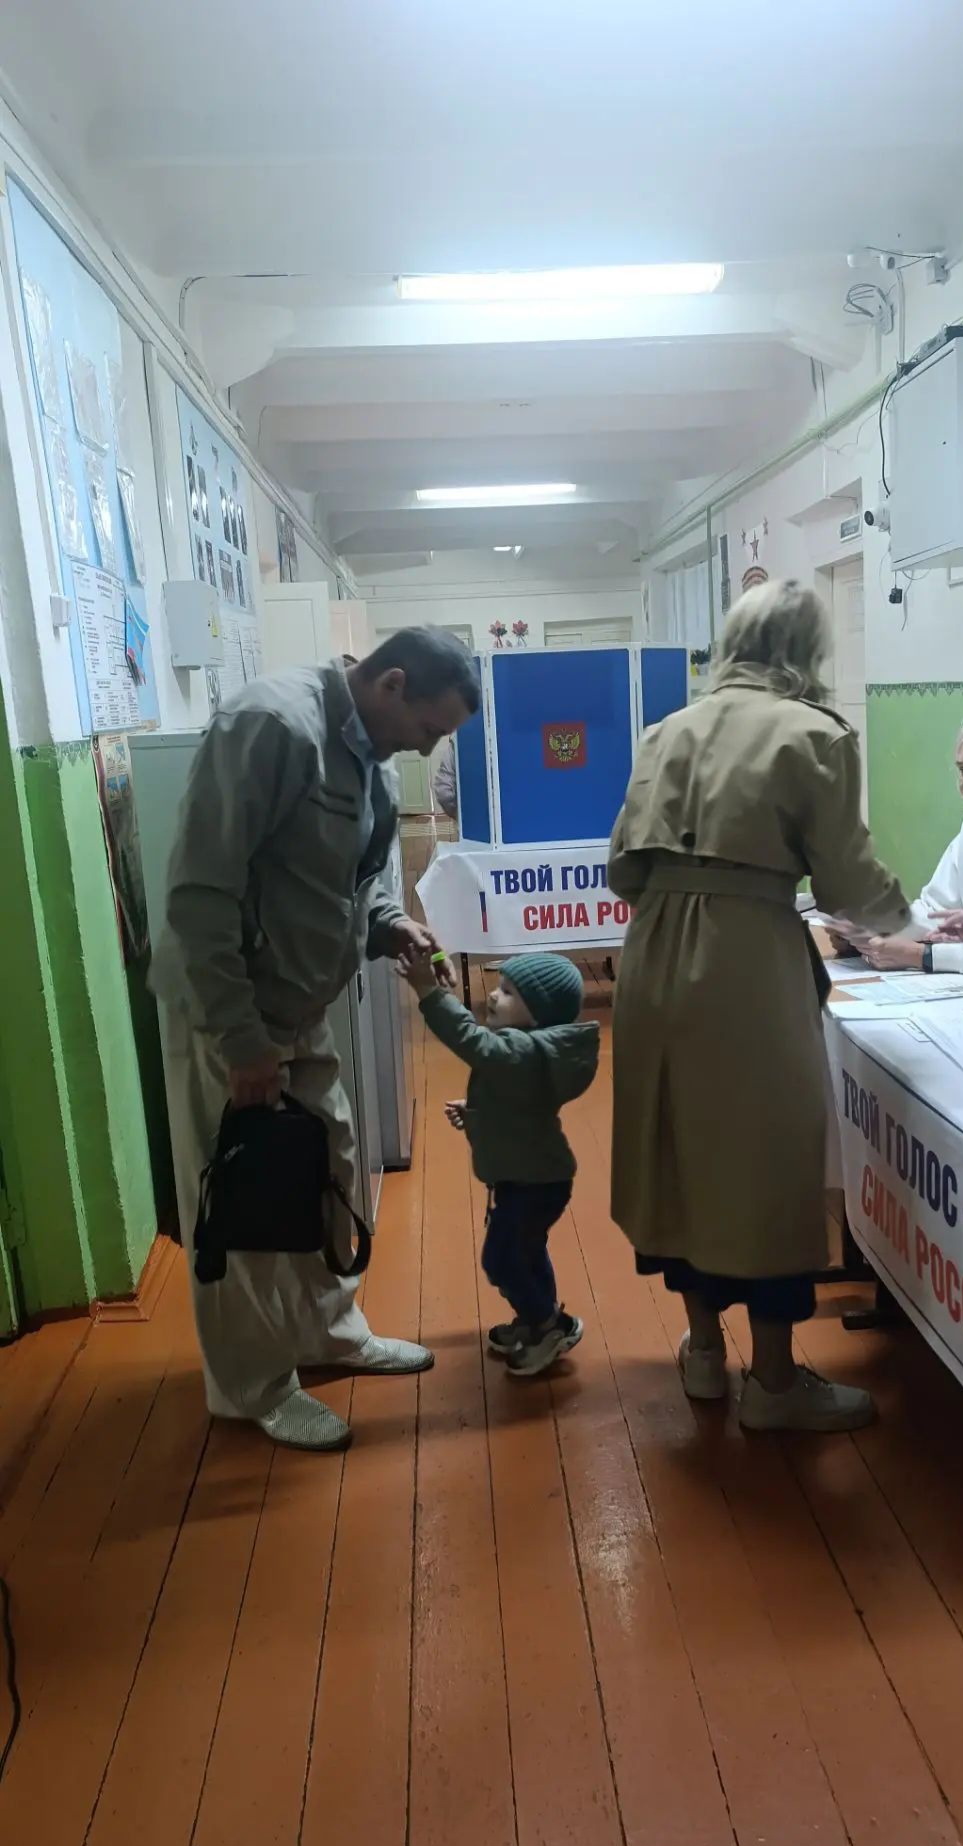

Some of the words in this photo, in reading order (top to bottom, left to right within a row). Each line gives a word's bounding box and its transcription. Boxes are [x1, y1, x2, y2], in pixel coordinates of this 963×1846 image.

[490, 863, 553, 895] ТВОЙ
[523, 902, 590, 931] СИЛА
[597, 899, 638, 926] РО
[842, 1067, 881, 1155] ТВОЙ
[885, 1111, 958, 1228] ГОЛОС
[861, 1164, 910, 1266] СИЛА
